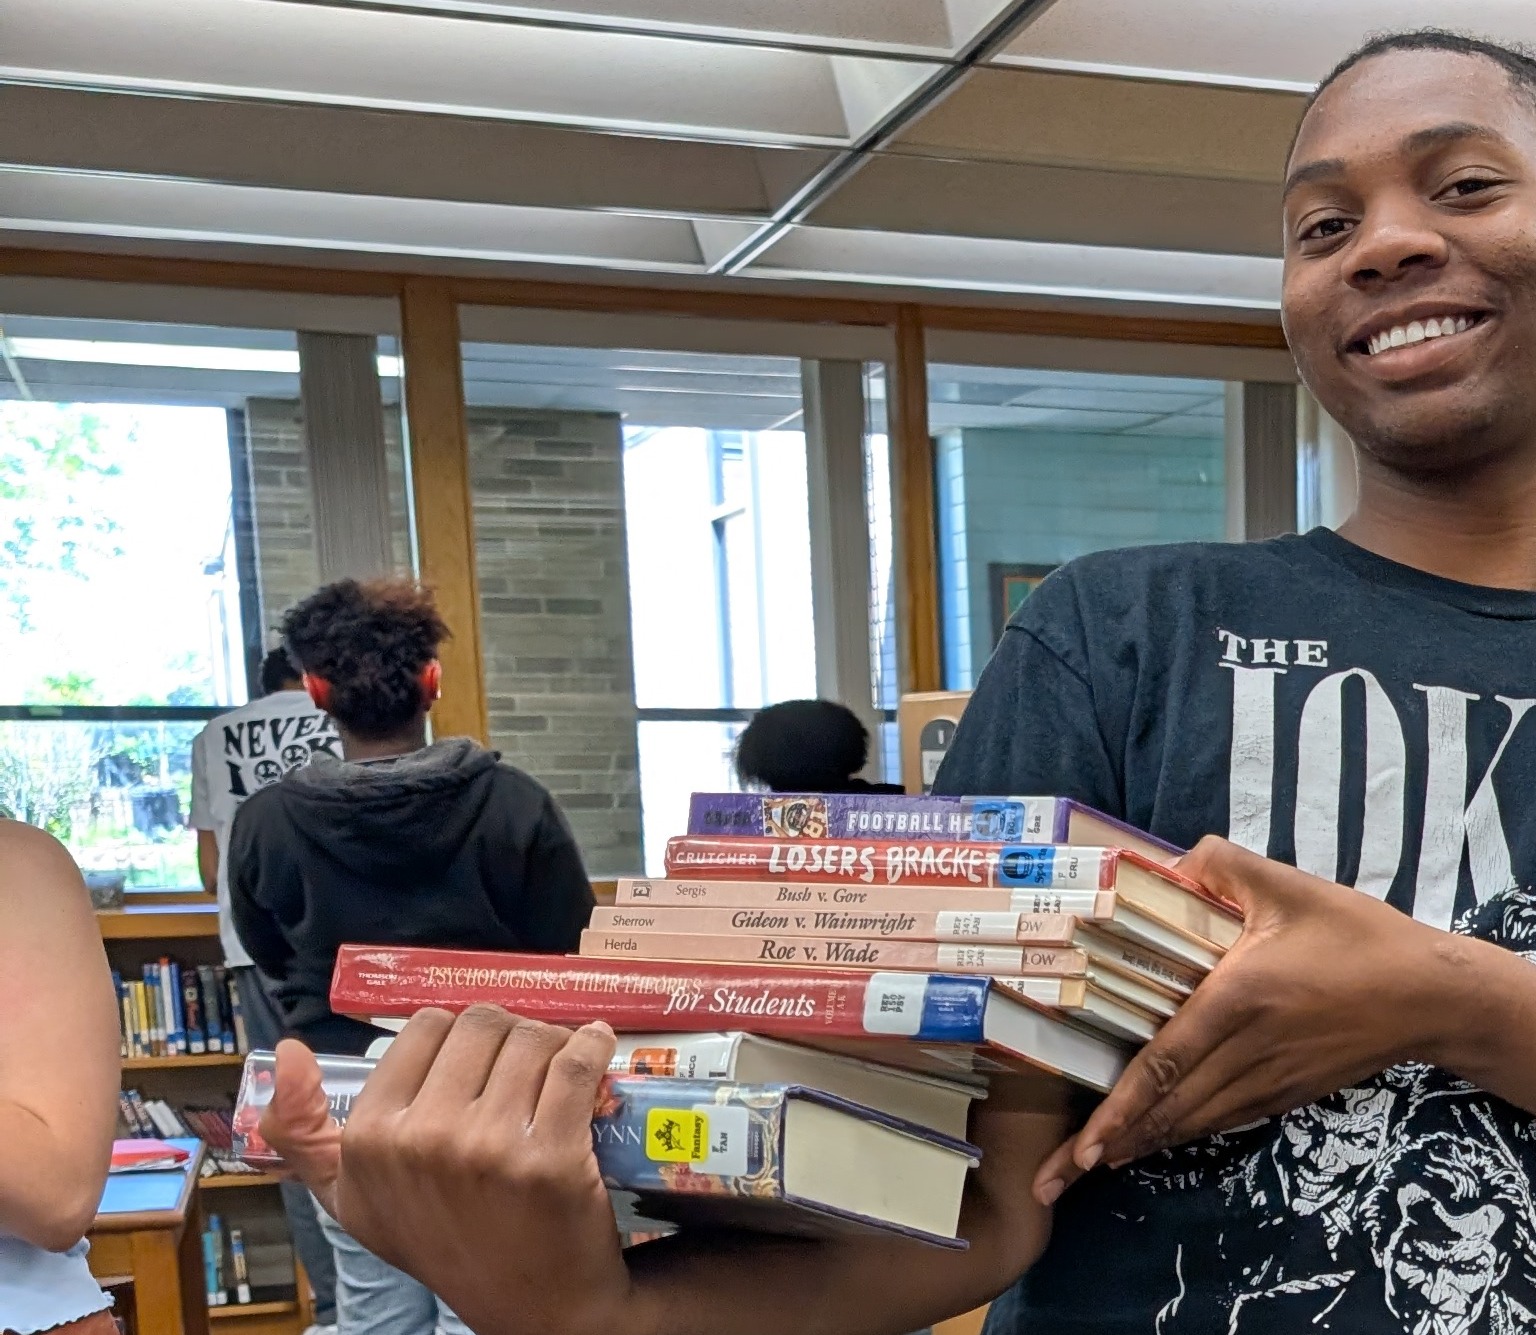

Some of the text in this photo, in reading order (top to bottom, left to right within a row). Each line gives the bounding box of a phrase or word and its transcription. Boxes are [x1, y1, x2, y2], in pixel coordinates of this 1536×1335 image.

[1217, 628, 1329, 667] THE
[847, 811, 943, 833] FOOTBALL
[1033, 815, 1042, 834] GRE
[674, 845, 1000, 887] CRUTCHER LOSERS BRACKET
[1068, 857, 1078, 879] CRU
[676, 884, 867, 904] Sergis Bush v. Gore
[611, 911, 917, 936] Sherrow Gideon v. Wainwright
[604, 938, 880, 963] Herda Roe v. Wade
[358, 972, 398, 981] THOMSON
[428, 966, 702, 997] PSYCHOLOGISTS & THEIR THEORIES
[663, 986, 816, 1017] for Students
[825, 989, 837, 1025] VOLUME
[880, 992, 888, 1013] REF
[688, 1055, 697, 1079] MCG
[592, 1123, 642, 1146] YNN
[691, 1116, 705, 1160] Fantasy
[712, 1145, 720, 1154] F
